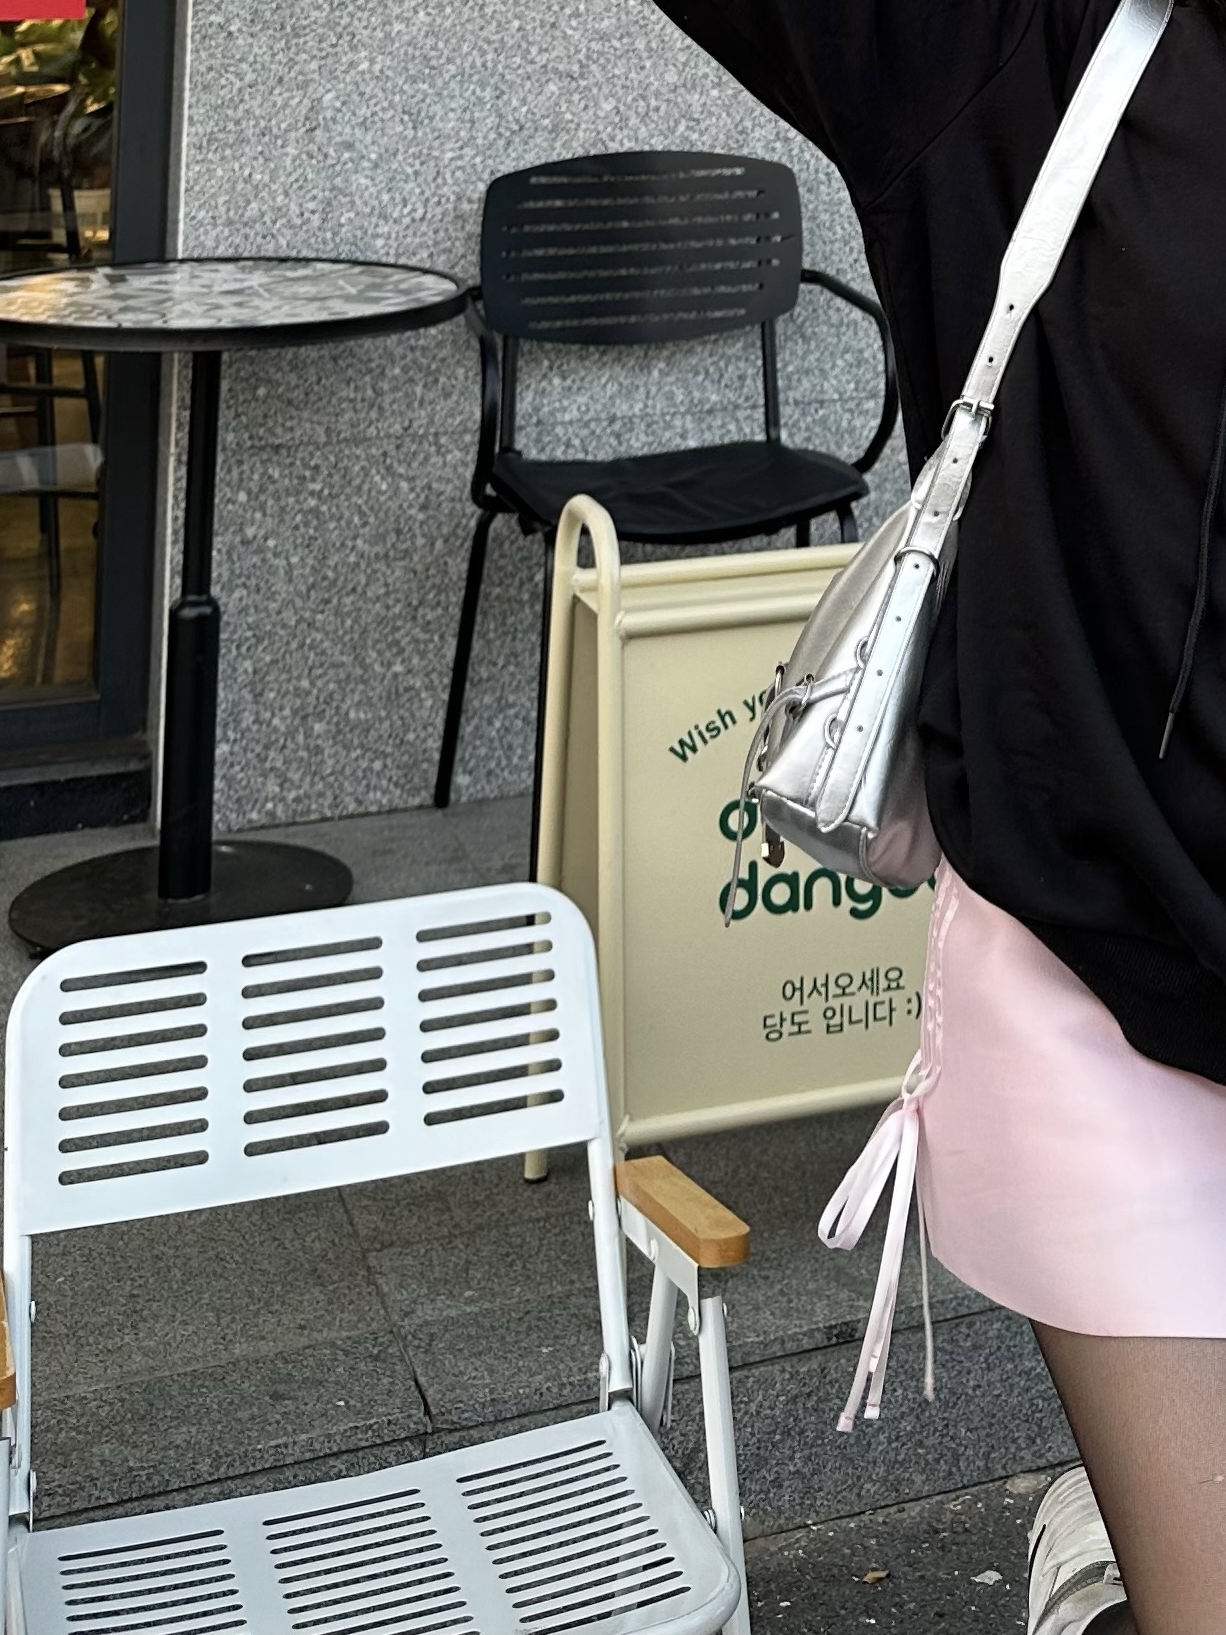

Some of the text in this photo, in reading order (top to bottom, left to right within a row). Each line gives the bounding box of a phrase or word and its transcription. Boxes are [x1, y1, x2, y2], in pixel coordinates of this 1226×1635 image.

[668, 707, 737, 763] Wish
[719, 859, 935, 920] dang
[782, 966, 905, 1006] 어서오세요
[763, 1009, 812, 1043] 당도
[822, 997, 897, 1035] 입니다
